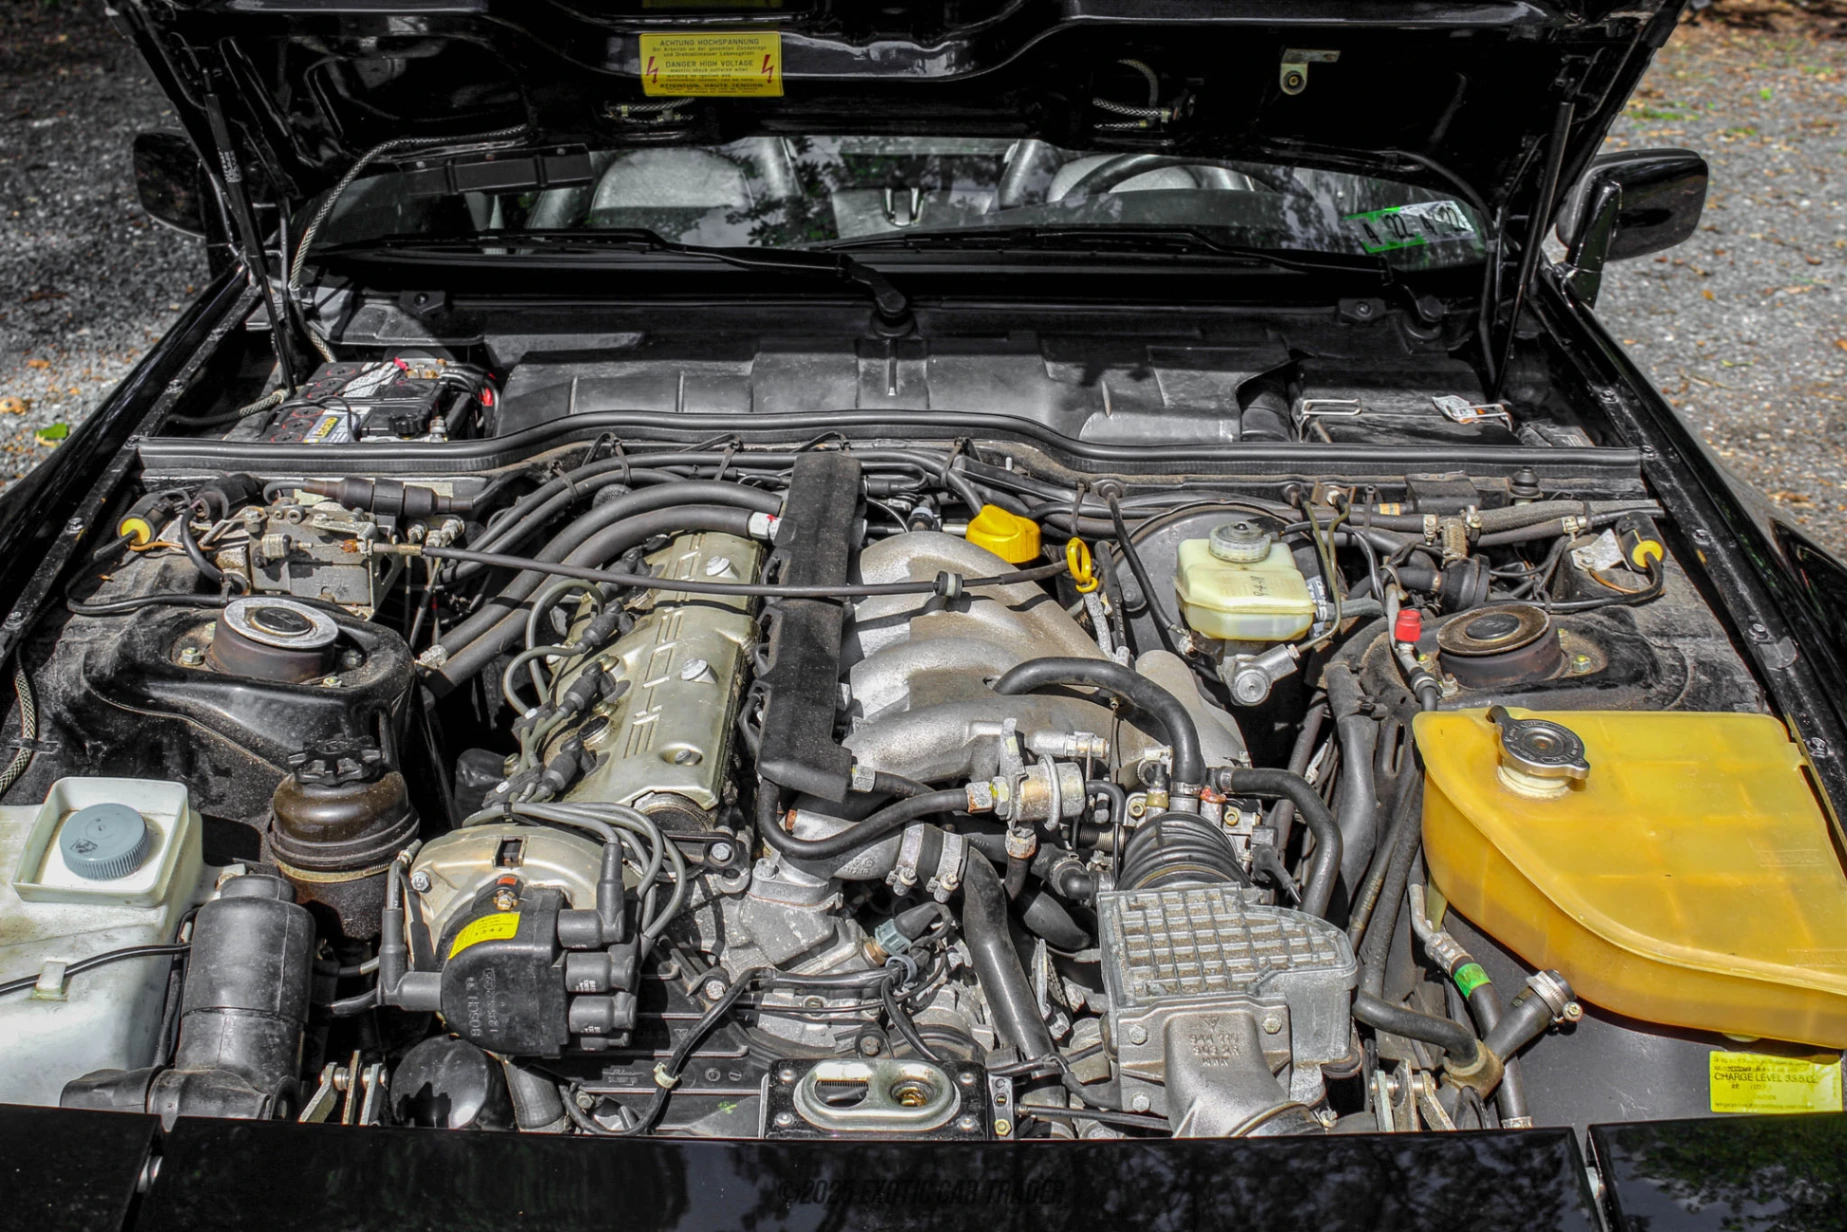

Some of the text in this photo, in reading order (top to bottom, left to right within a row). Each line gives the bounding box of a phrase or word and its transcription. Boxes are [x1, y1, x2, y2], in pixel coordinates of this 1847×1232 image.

[1362, 213, 1415, 245] 4 22
[467, 996, 482, 1037] BOSCH
[1714, 1072, 1753, 1081] CHARGE
[1755, 1073, 1782, 1082] LEVEL
